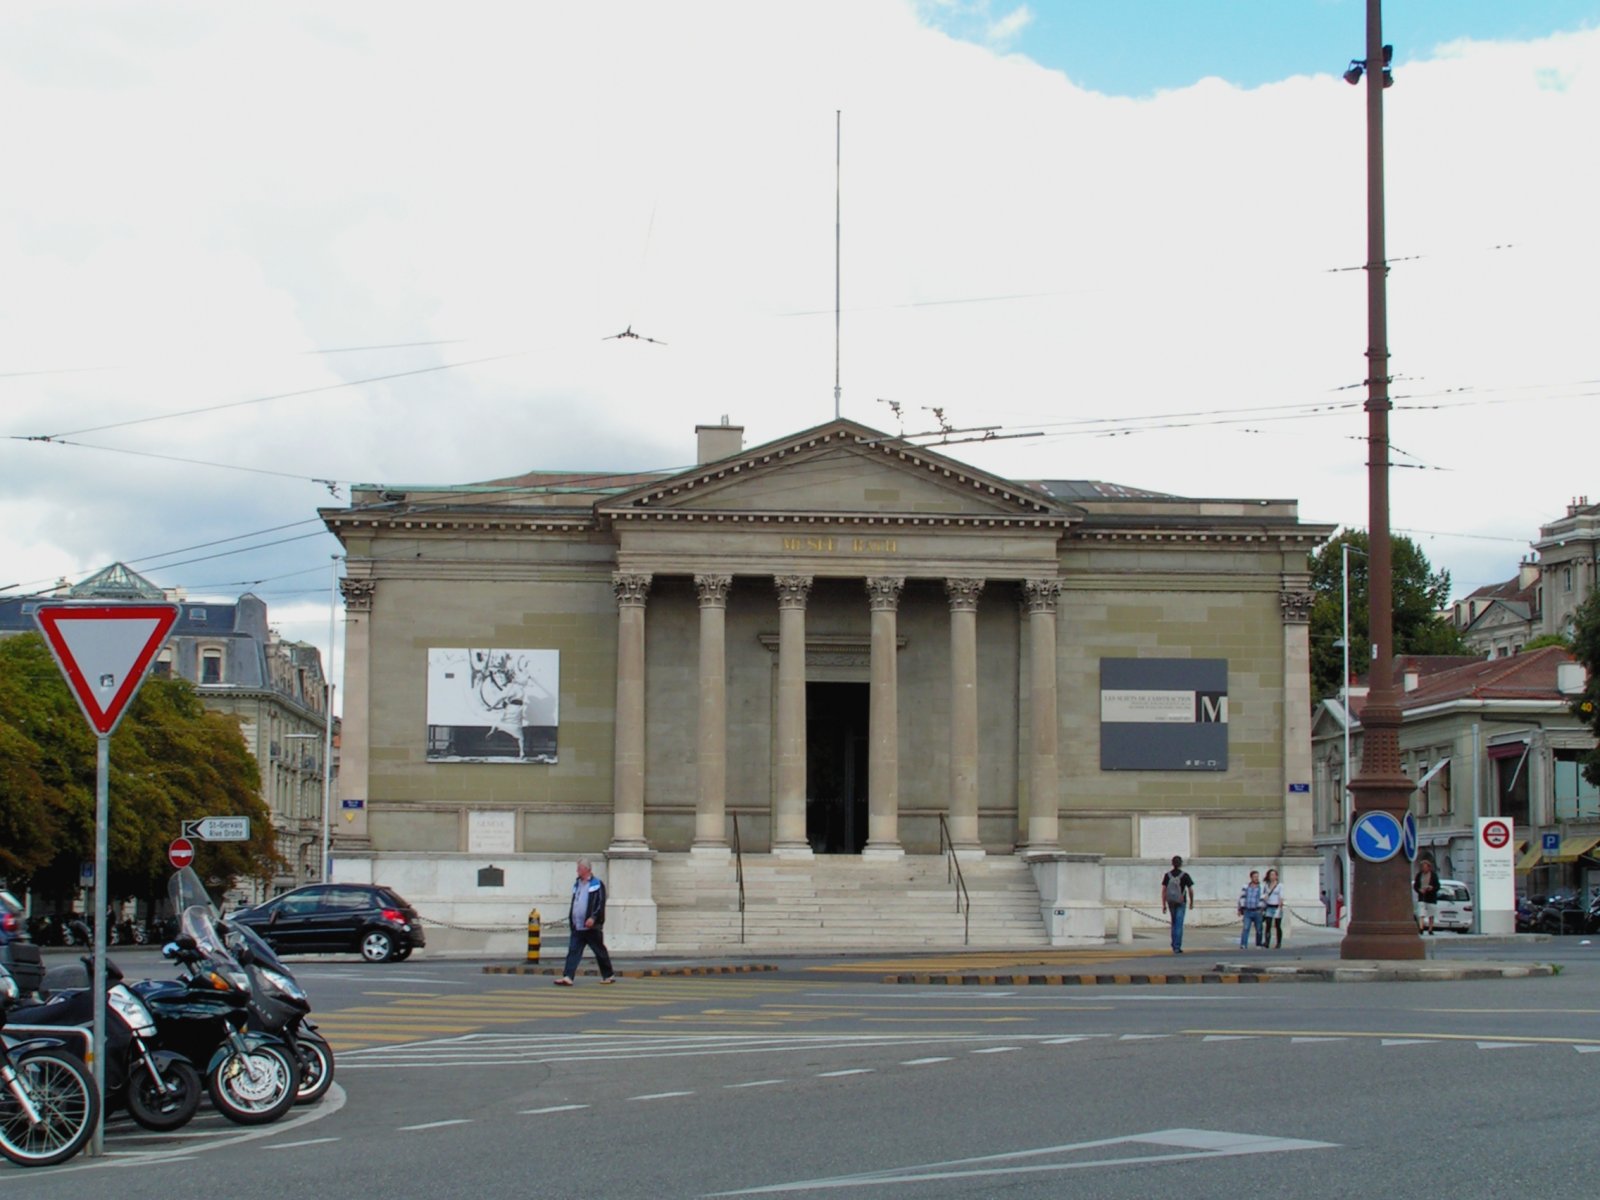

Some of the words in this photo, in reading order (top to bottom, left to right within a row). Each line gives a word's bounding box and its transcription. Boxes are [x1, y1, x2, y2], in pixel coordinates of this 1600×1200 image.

[853, 538, 896, 552] RATH
[1201, 695, 1228, 723] M
[209, 829, 222, 837] Rive
[224, 829, 243, 837] Droite
[1546, 835, 1556, 848] P
